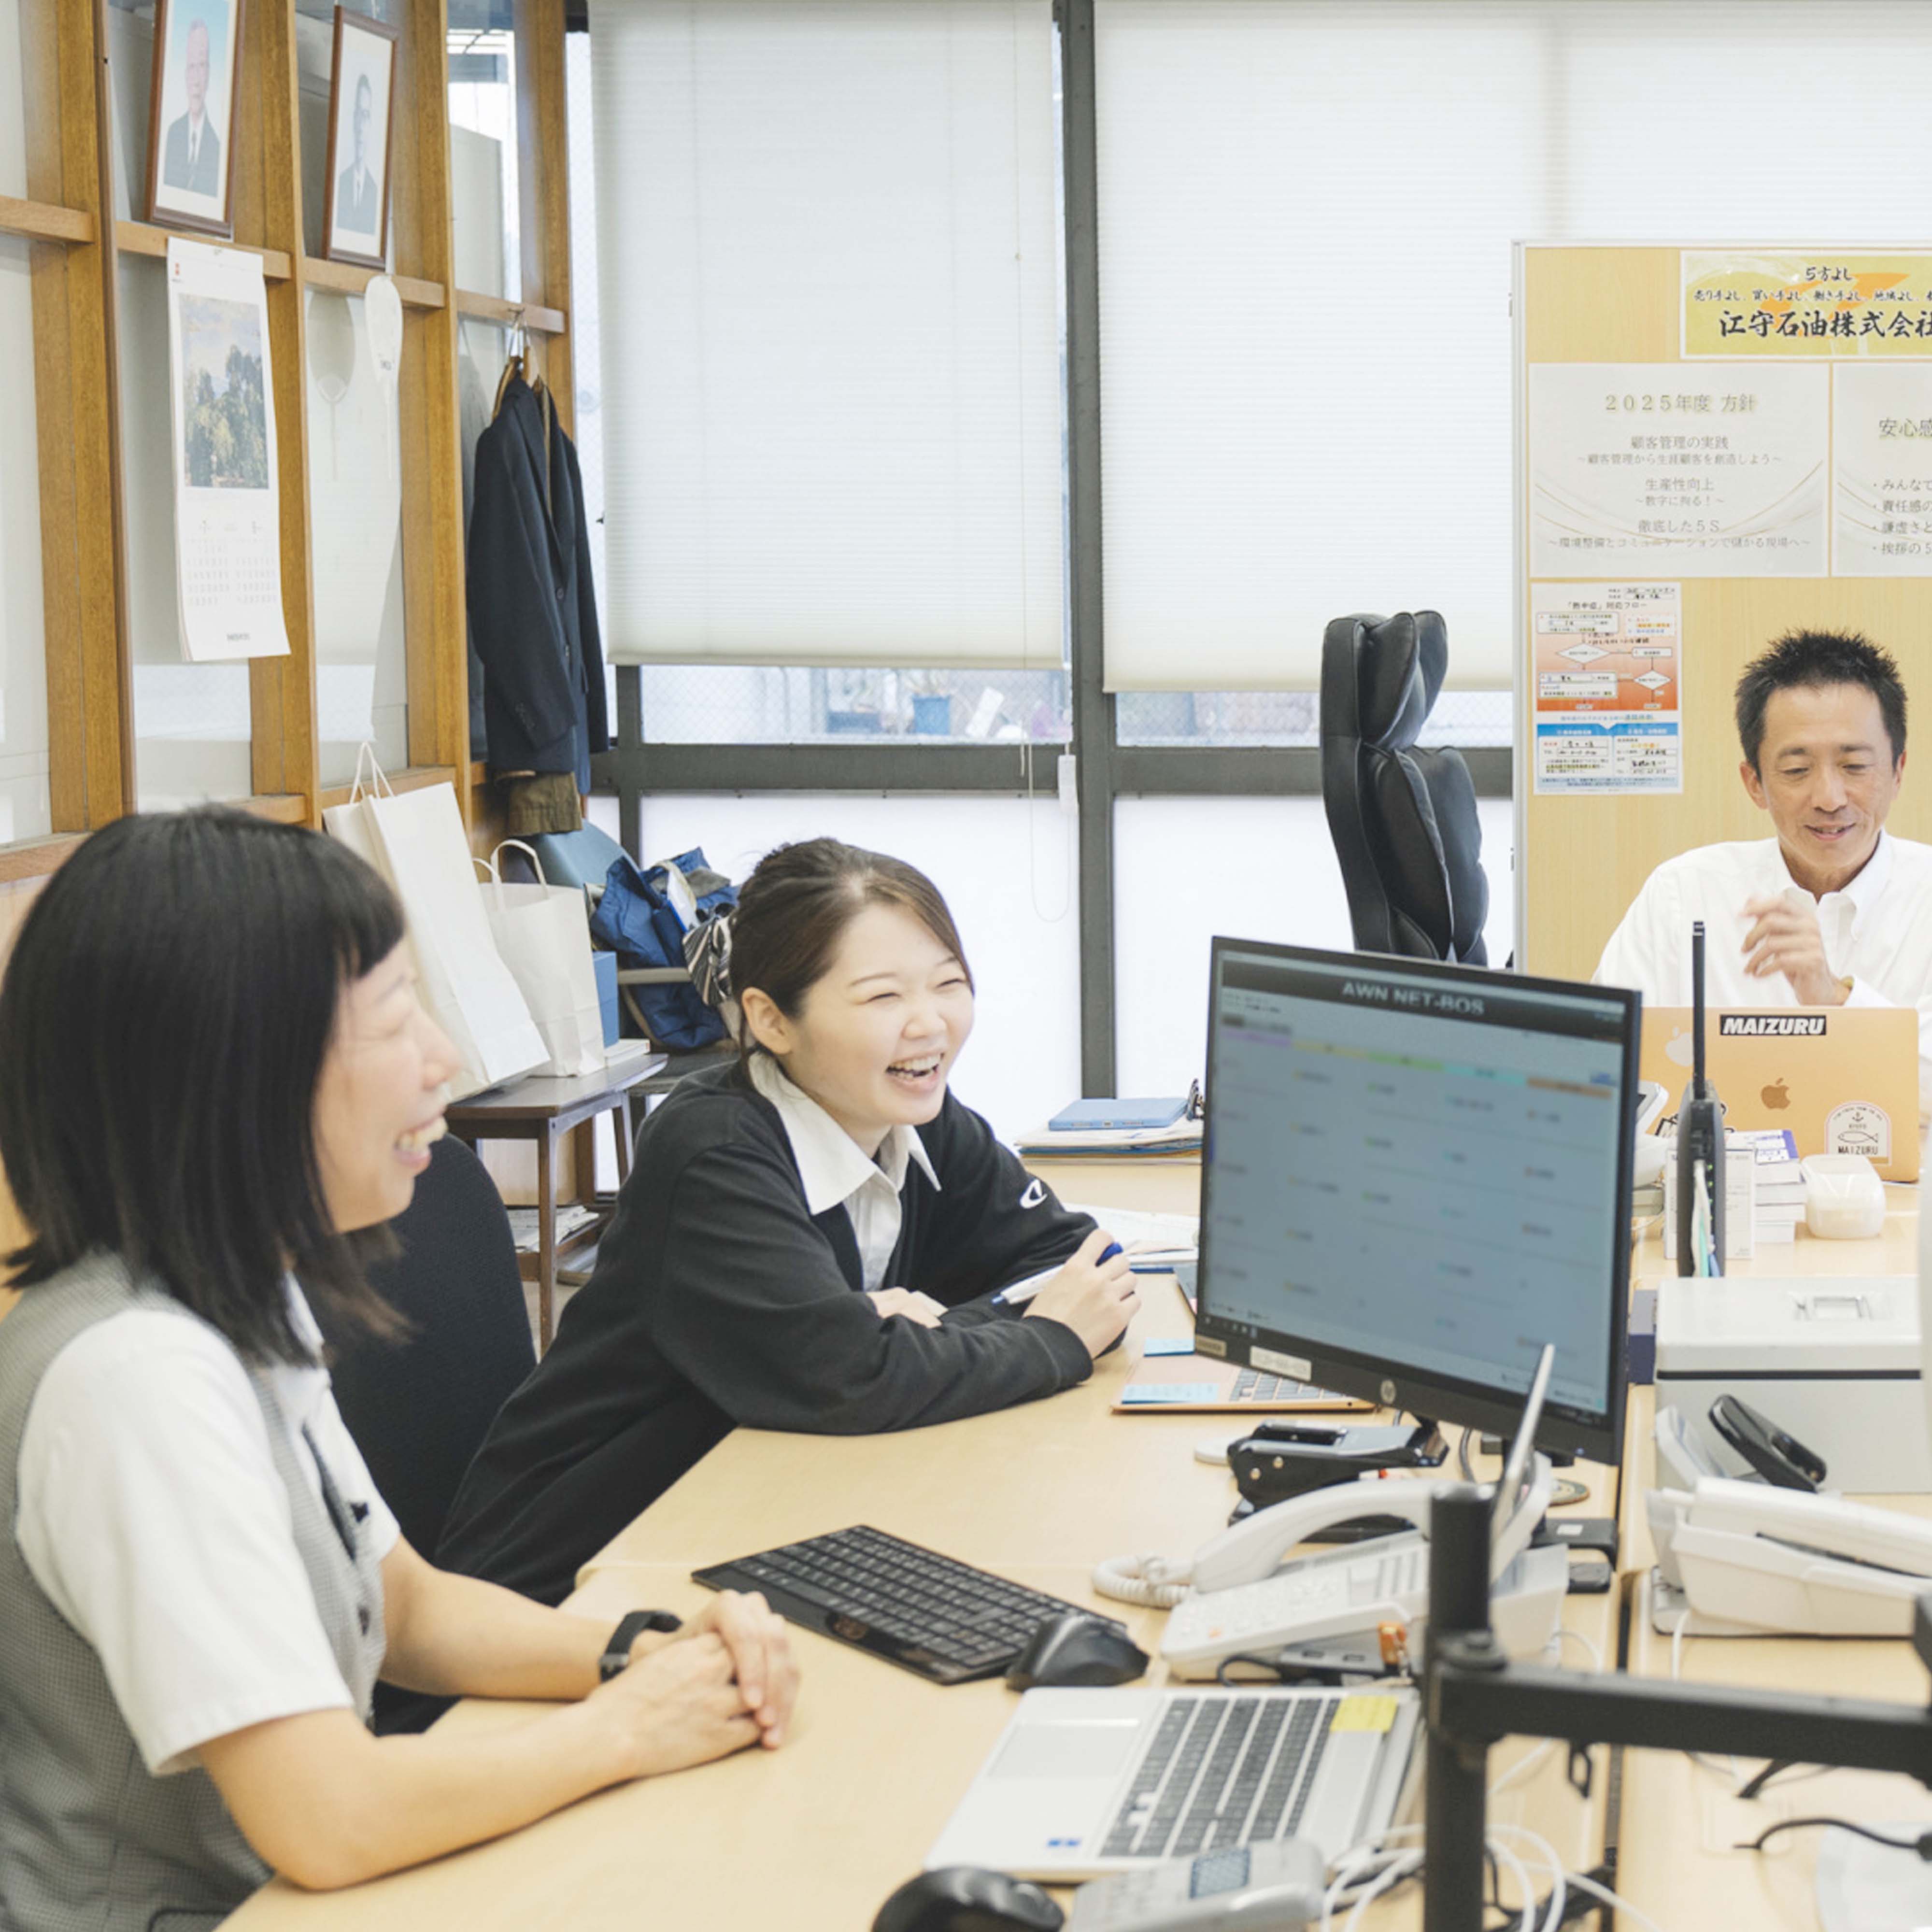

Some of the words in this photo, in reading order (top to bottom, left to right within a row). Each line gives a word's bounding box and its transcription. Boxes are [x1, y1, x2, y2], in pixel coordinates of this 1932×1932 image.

[1805, 267, 1853, 281] 5方よし
[1719, 310, 1932, 338] 江守石油株式会社
[1605, 394, 1711, 412] 2025年度
[1721, 394, 1755, 412] 方針
[1878, 417, 1932, 437] 安心感
[1631, 436, 1729, 449] 顧客管理の実践
[1645, 478, 1715, 491] 生産性向上
[1638, 519, 1720, 533] 徹底した5S
[1342, 981, 1388, 1000] AWN
[1393, 988, 1485, 1016] NET-BOS
[1722, 1017, 1825, 1035] MAIZURU
[1838, 1146, 1878, 1155] MAIZURU
